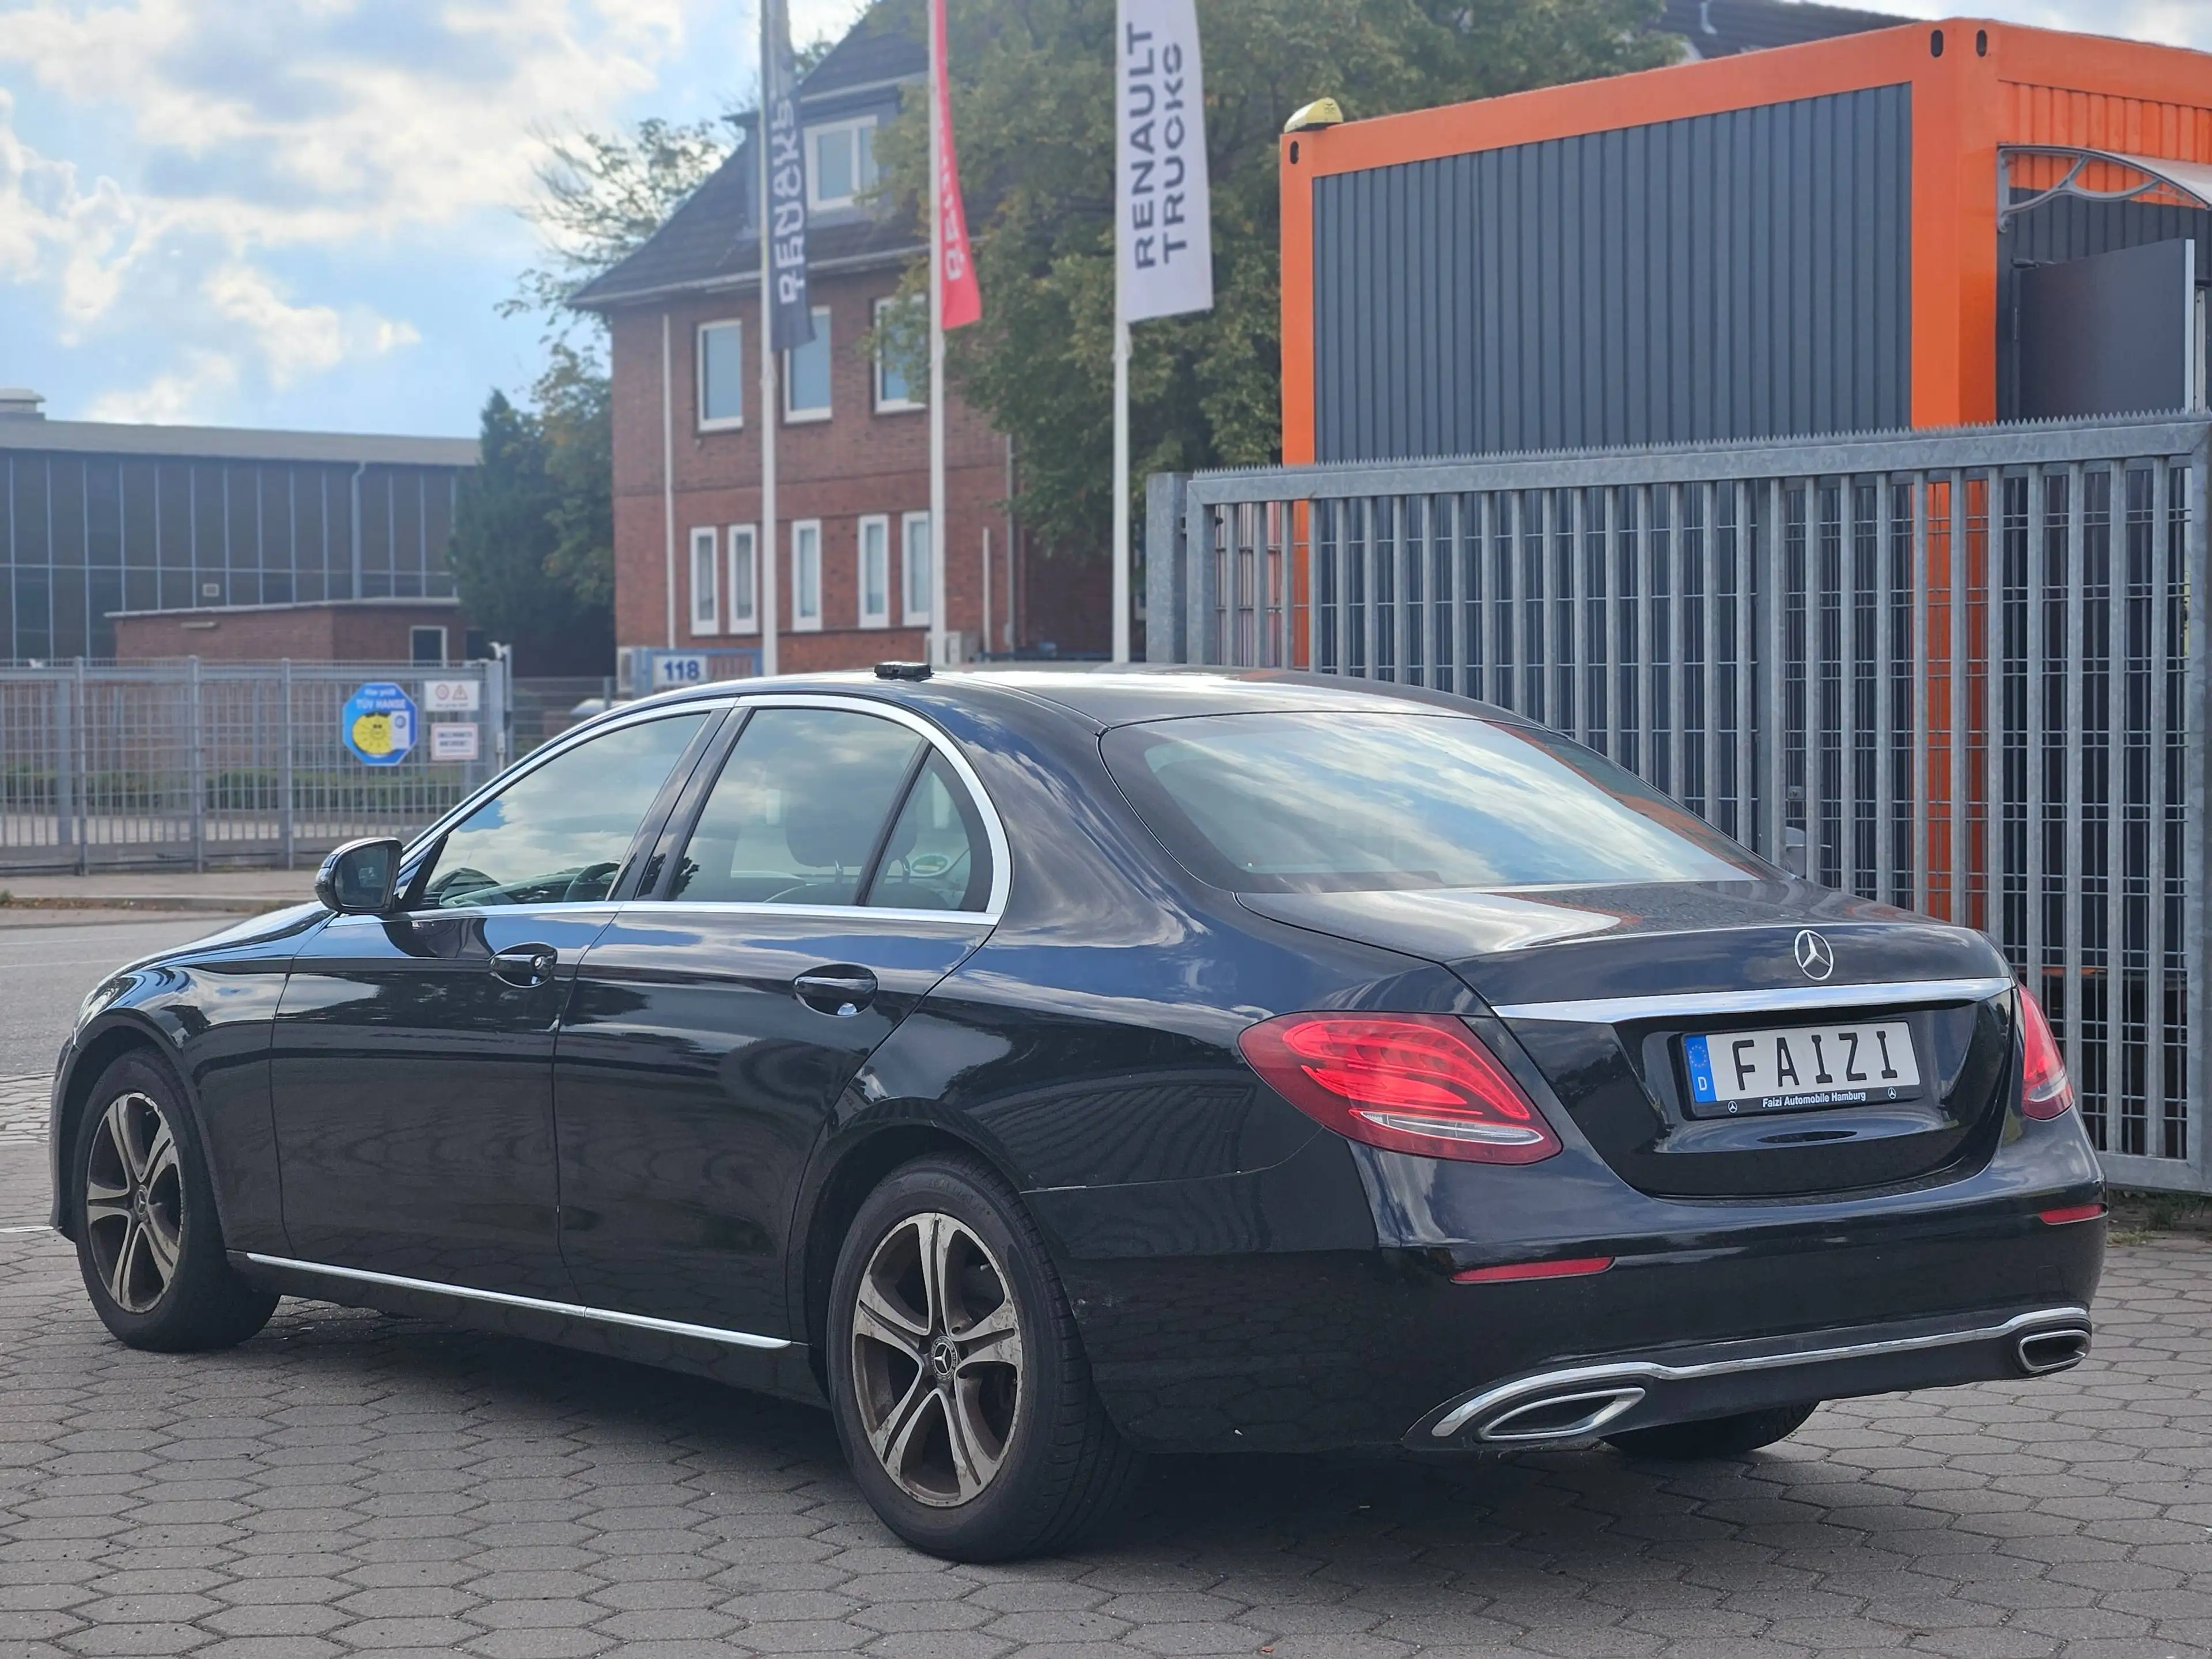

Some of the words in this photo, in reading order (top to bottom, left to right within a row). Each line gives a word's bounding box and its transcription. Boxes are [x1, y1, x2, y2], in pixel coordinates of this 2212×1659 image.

[1126, 22, 1157, 270] RENAULT
[1162, 42, 1187, 264] TRUCKS
[664, 660, 700, 681] 118
[1732, 1031, 1898, 1091] FAIZI
[1698, 1076, 1708, 1091] D
[1763, 1097, 1782, 1108] Faizi
[1784, 1094, 1830, 1106] Automobile
[1831, 1092, 1866, 1101] Hamburg
